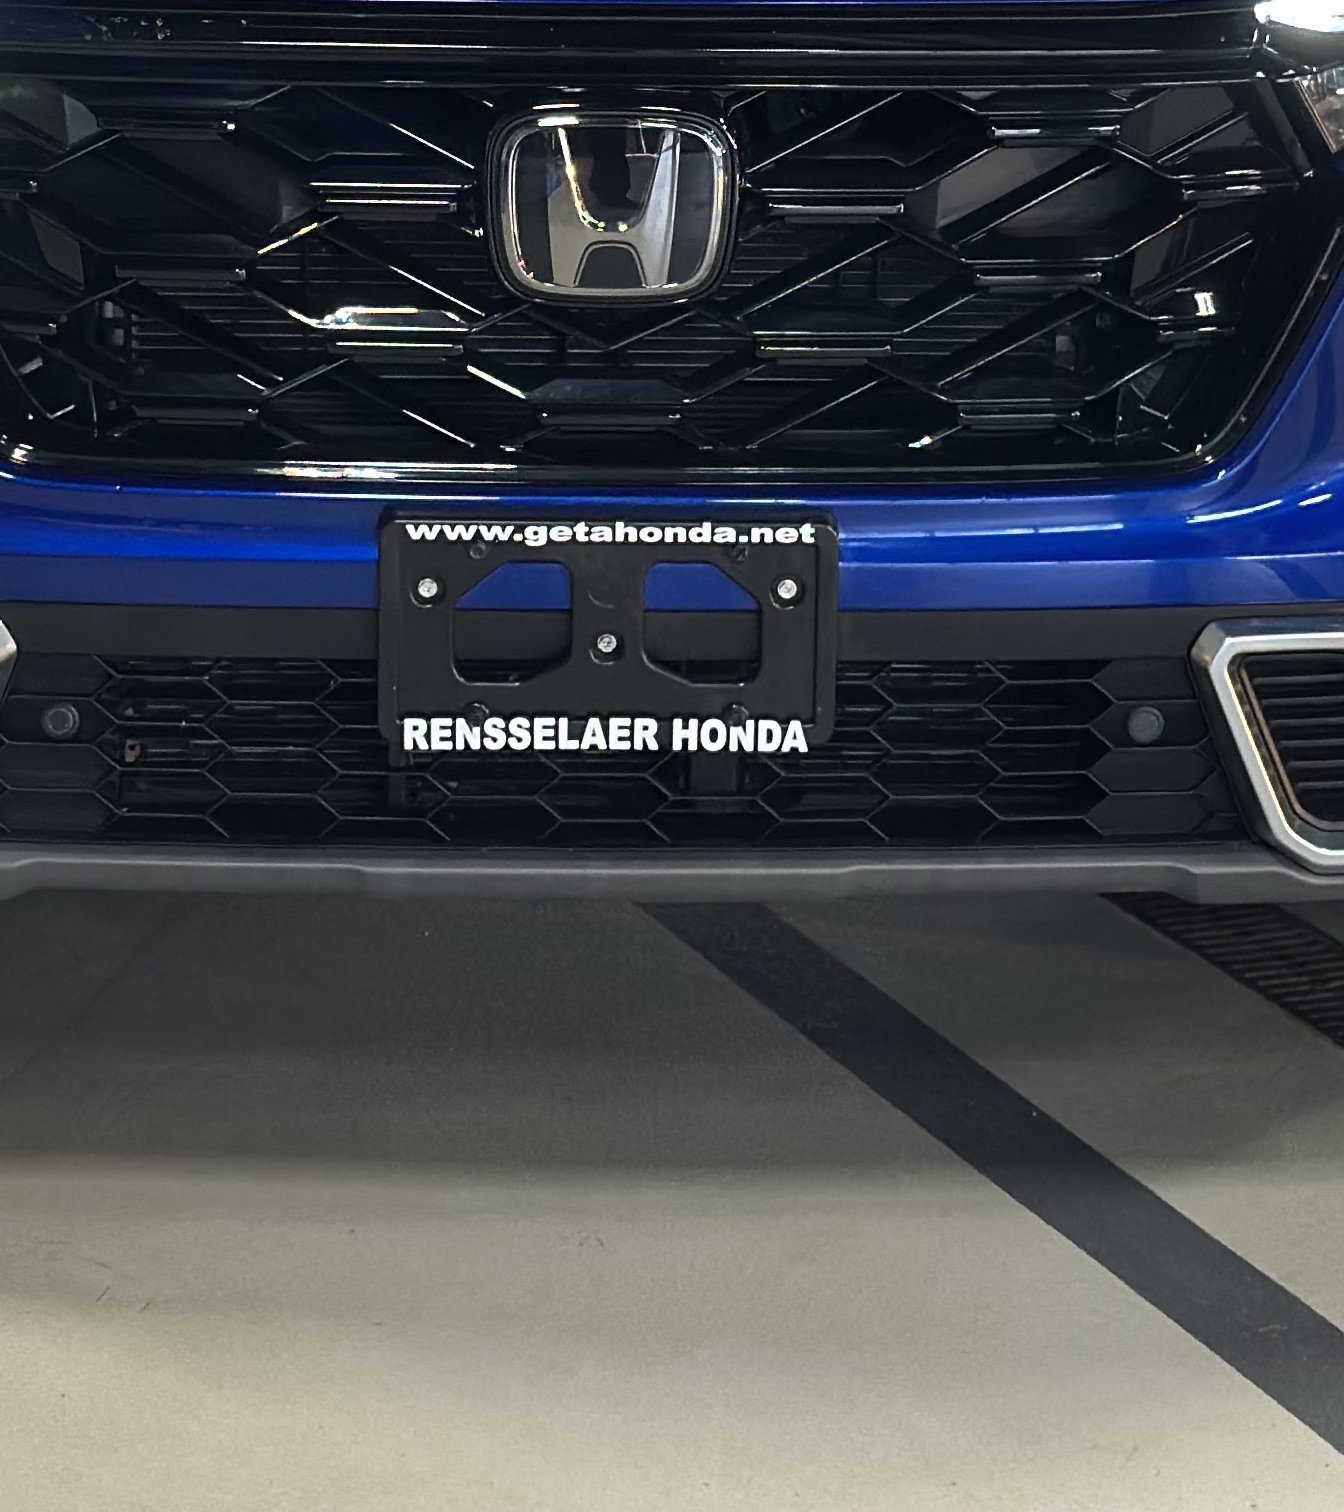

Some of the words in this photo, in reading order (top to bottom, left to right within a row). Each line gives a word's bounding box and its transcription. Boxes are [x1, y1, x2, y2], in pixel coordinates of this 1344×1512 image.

[404, 521, 816, 547] www.getahonda.net
[402, 716, 660, 752] RENSSELAER
[671, 717, 809, 753] HONDA
